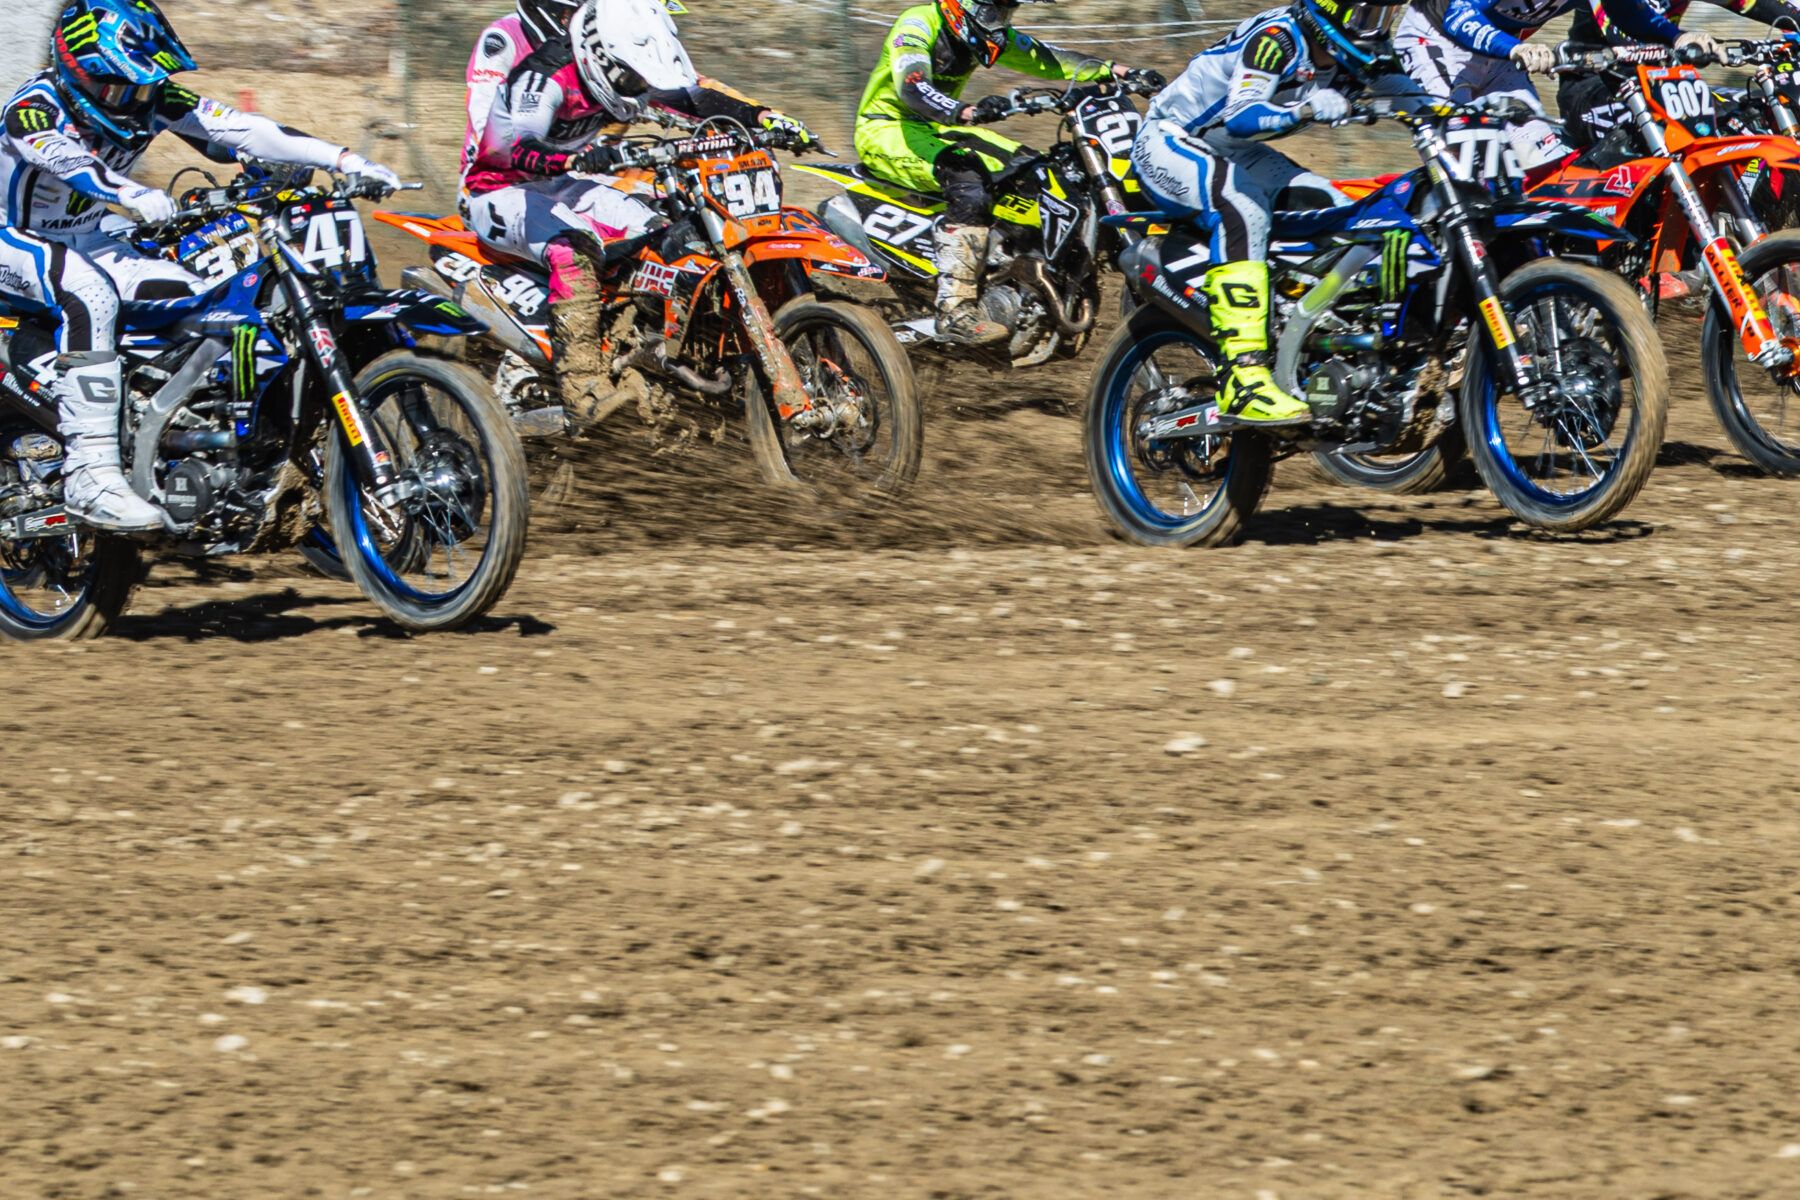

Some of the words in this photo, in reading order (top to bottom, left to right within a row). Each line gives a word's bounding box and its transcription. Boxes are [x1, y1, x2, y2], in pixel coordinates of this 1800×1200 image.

[1660, 78, 1715, 120] 602
[722, 169, 781, 218] 94
[302, 209, 366, 270] 47
[863, 203, 933, 246] 27
